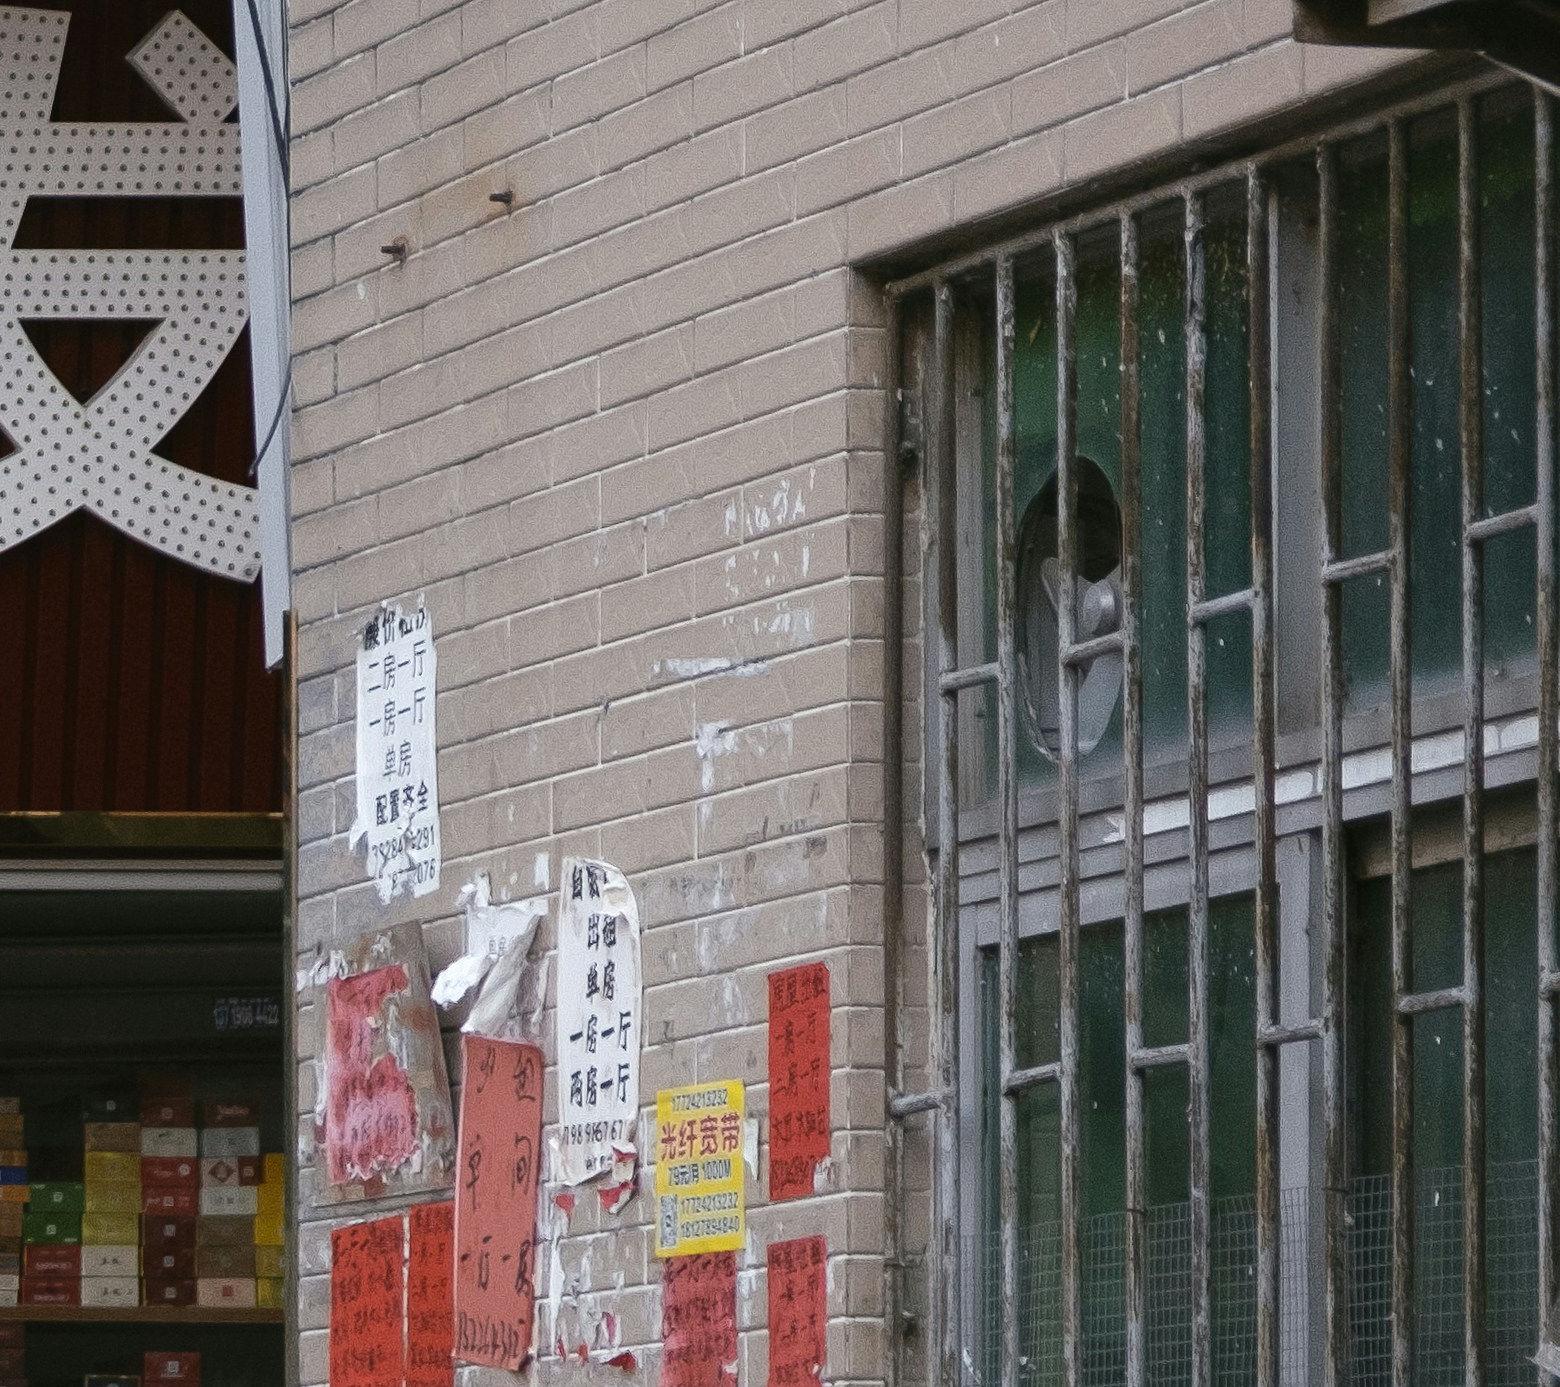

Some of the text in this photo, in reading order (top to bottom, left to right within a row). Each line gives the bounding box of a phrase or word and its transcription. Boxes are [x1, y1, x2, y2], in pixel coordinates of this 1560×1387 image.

[369, 686, 425, 736] 一房一厅
[382, 739, 411, 781] 单房
[570, 1011, 632, 1054] 一房一厅
[570, 1062, 631, 1106] 两房一厅
[660, 1111, 740, 1162] 光纤宽带
